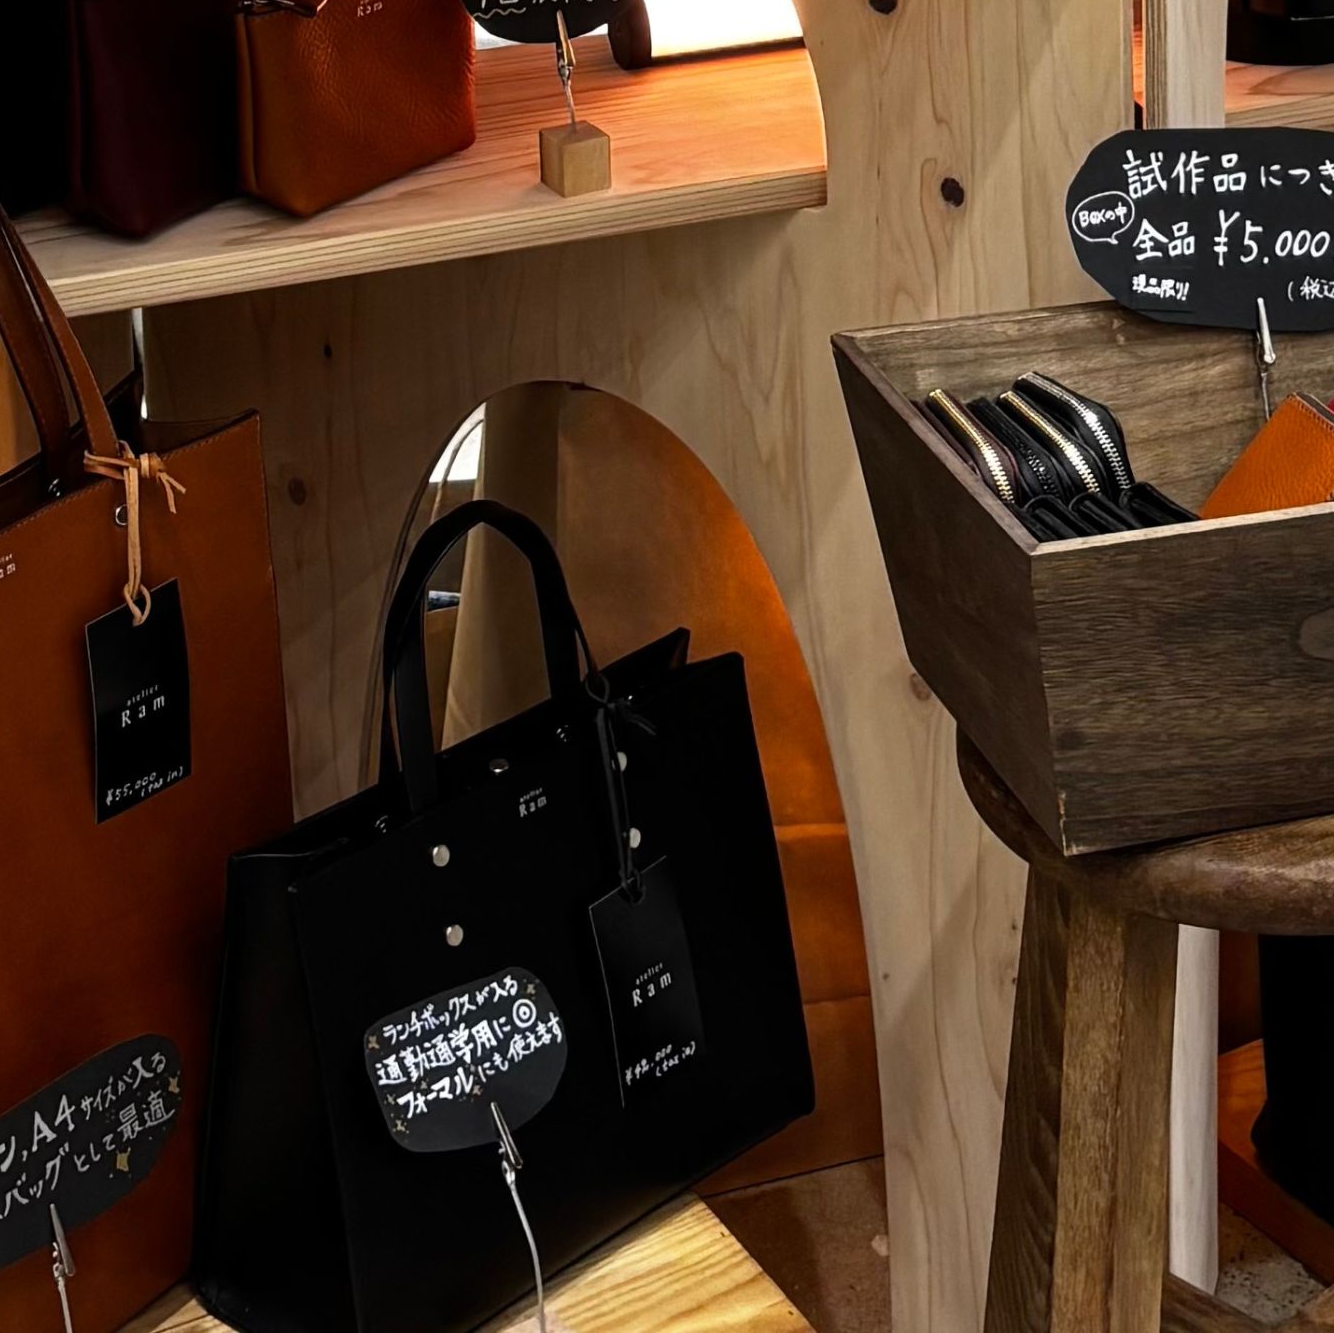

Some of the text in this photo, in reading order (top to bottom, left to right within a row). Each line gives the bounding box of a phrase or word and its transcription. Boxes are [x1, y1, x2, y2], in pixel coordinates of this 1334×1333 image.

[1079, 202, 1128, 227] BOXの中
[121, 694, 165, 728] Ram
[519, 795, 547, 818] Ram
[632, 973, 672, 1007] Ram
[383, 975, 518, 1045] ランチボックスが入る
[396, 1011, 563, 1118] フォーマルにも使えます
